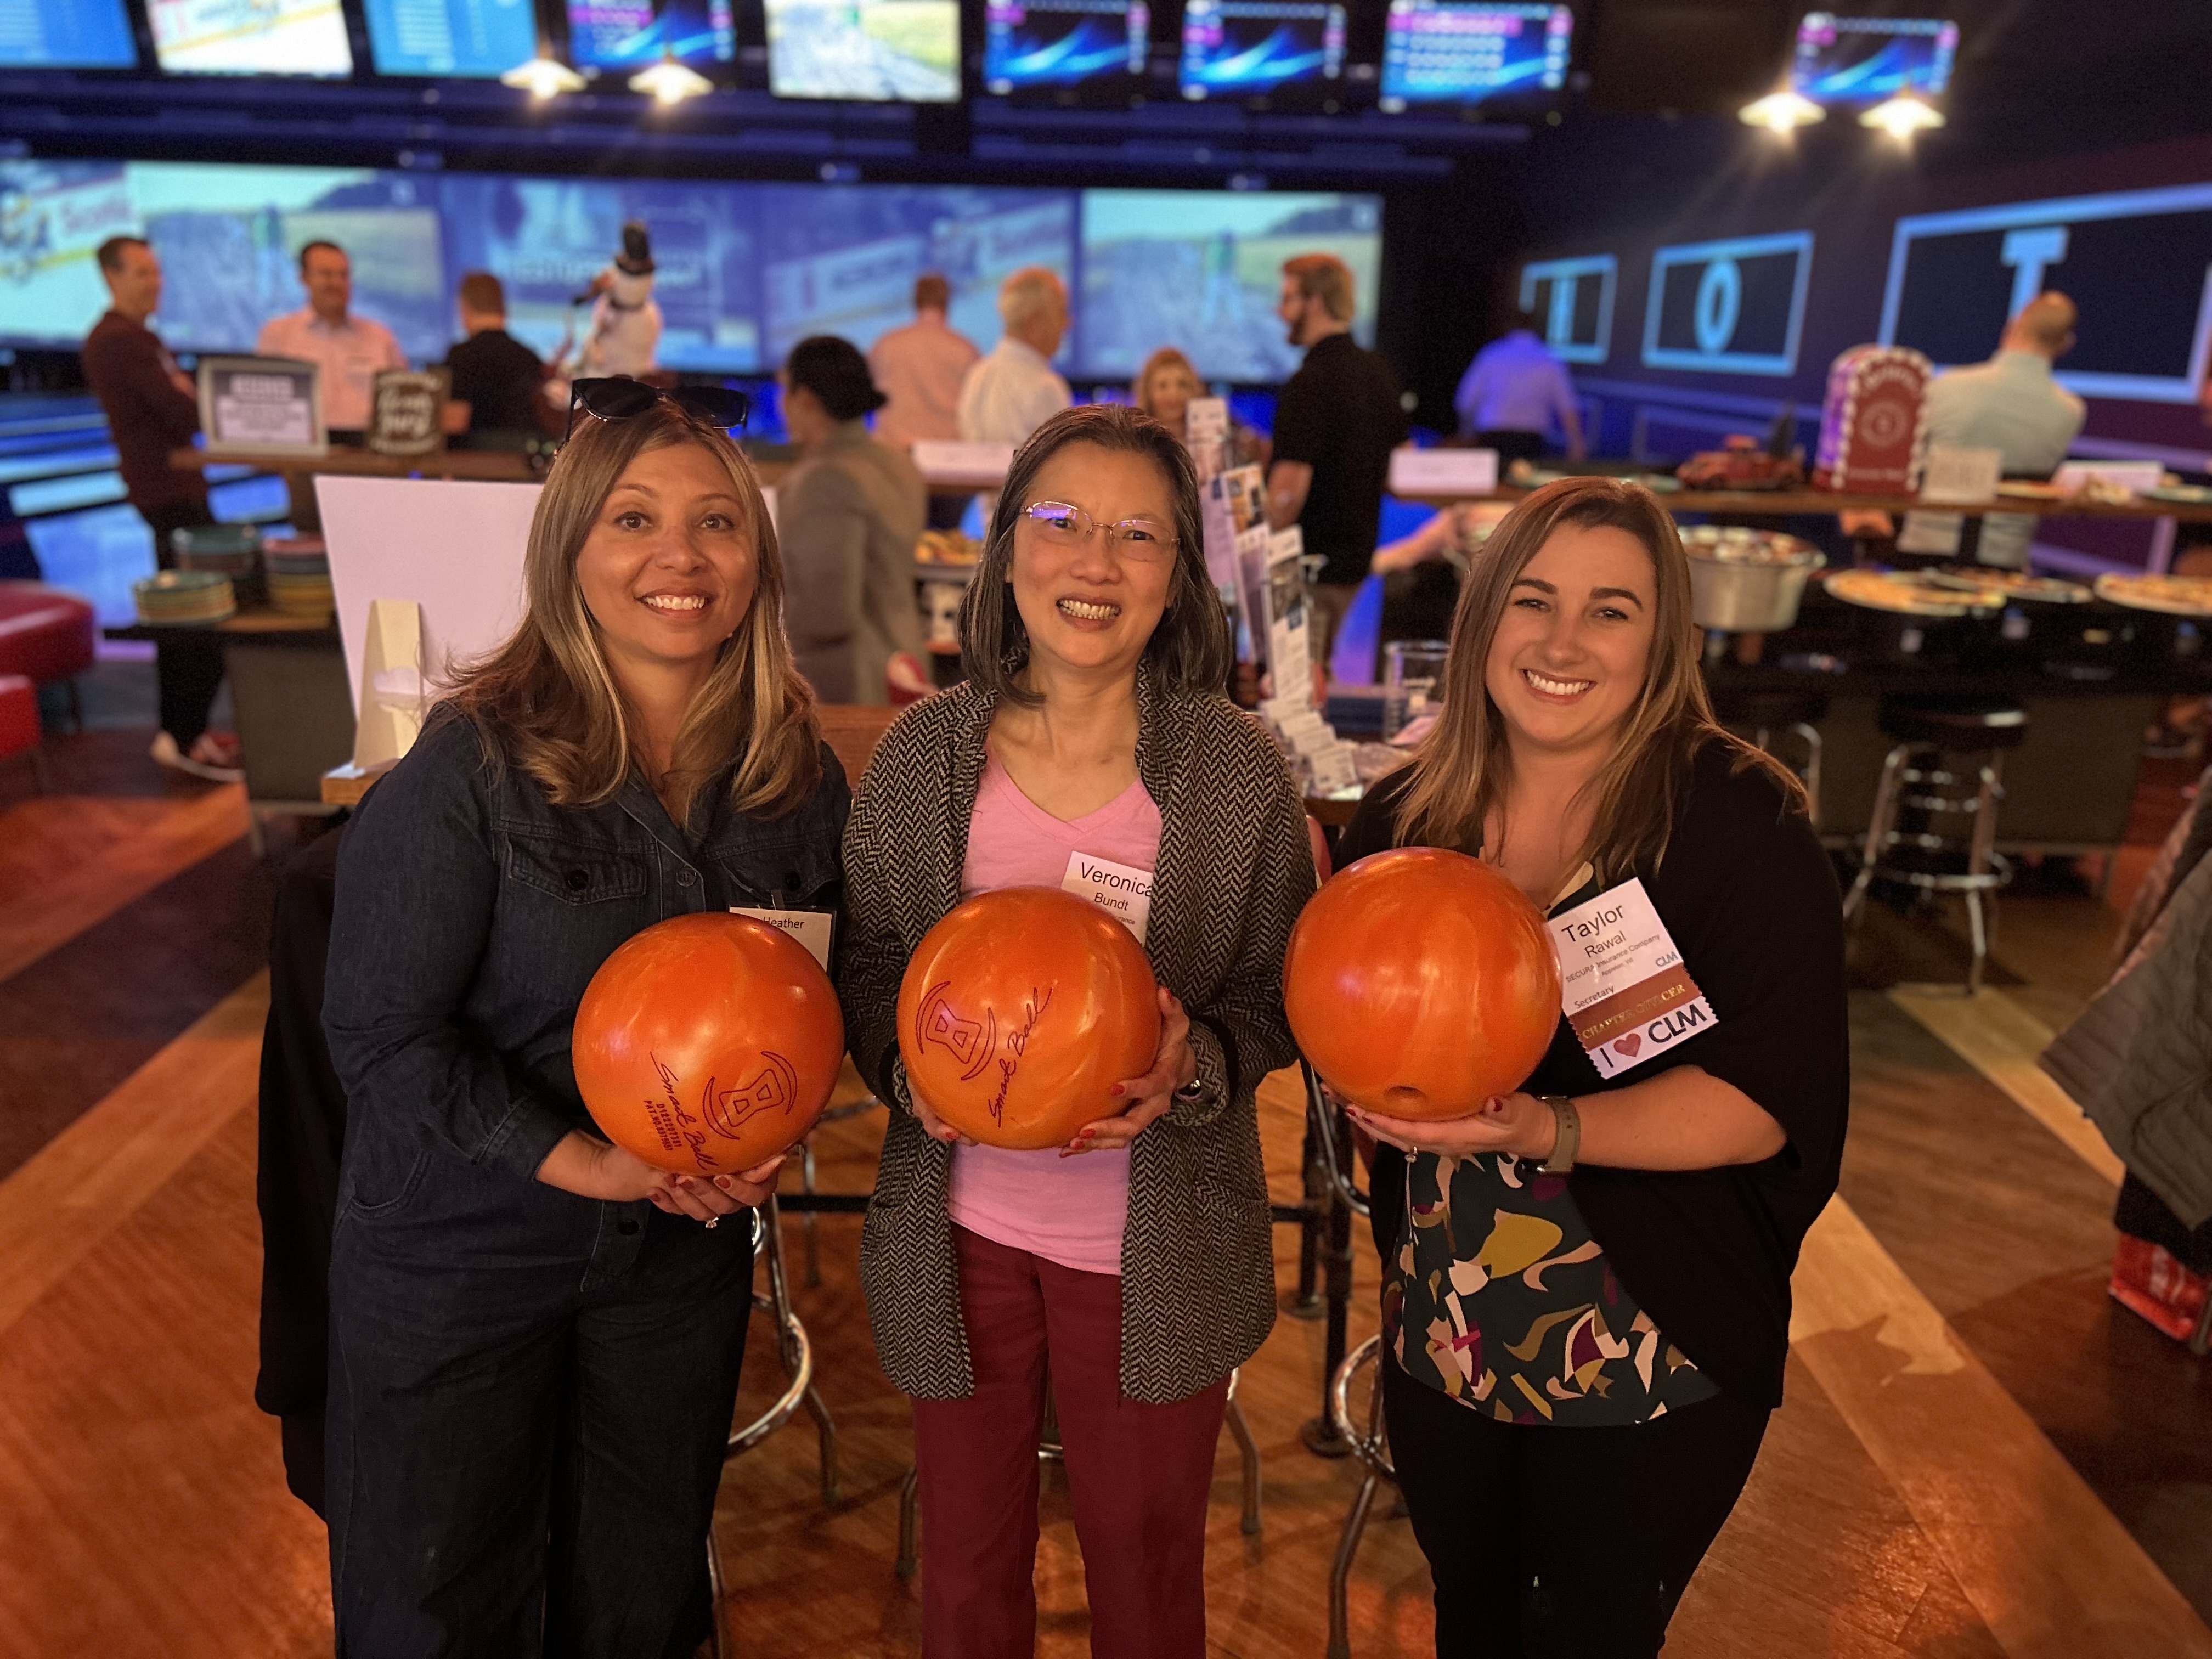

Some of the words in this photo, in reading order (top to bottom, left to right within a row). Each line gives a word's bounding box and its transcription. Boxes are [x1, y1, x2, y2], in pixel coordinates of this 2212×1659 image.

[1081, 862, 1153, 897] Veronica
[1094, 892, 1129, 911] Bundt
[1561, 905, 1624, 942] Taylor
[1565, 966, 1594, 983] SECURA
[1596, 949, 1628, 968] Insurance
[1628, 934, 1660, 952] Company
[1584, 930, 1627, 958] Rawal
[1655, 951, 1679, 967] CLM
[1574, 986, 1614, 1009] Secretary
[1600, 1047, 1614, 1068] I
[1648, 1003, 1708, 1043] CLM
[988, 1058, 1017, 1128] Smart
[1008, 988, 1052, 1057] Ball
[649, 1051, 697, 1128] Smart
[683, 1131, 719, 1171] Ball
